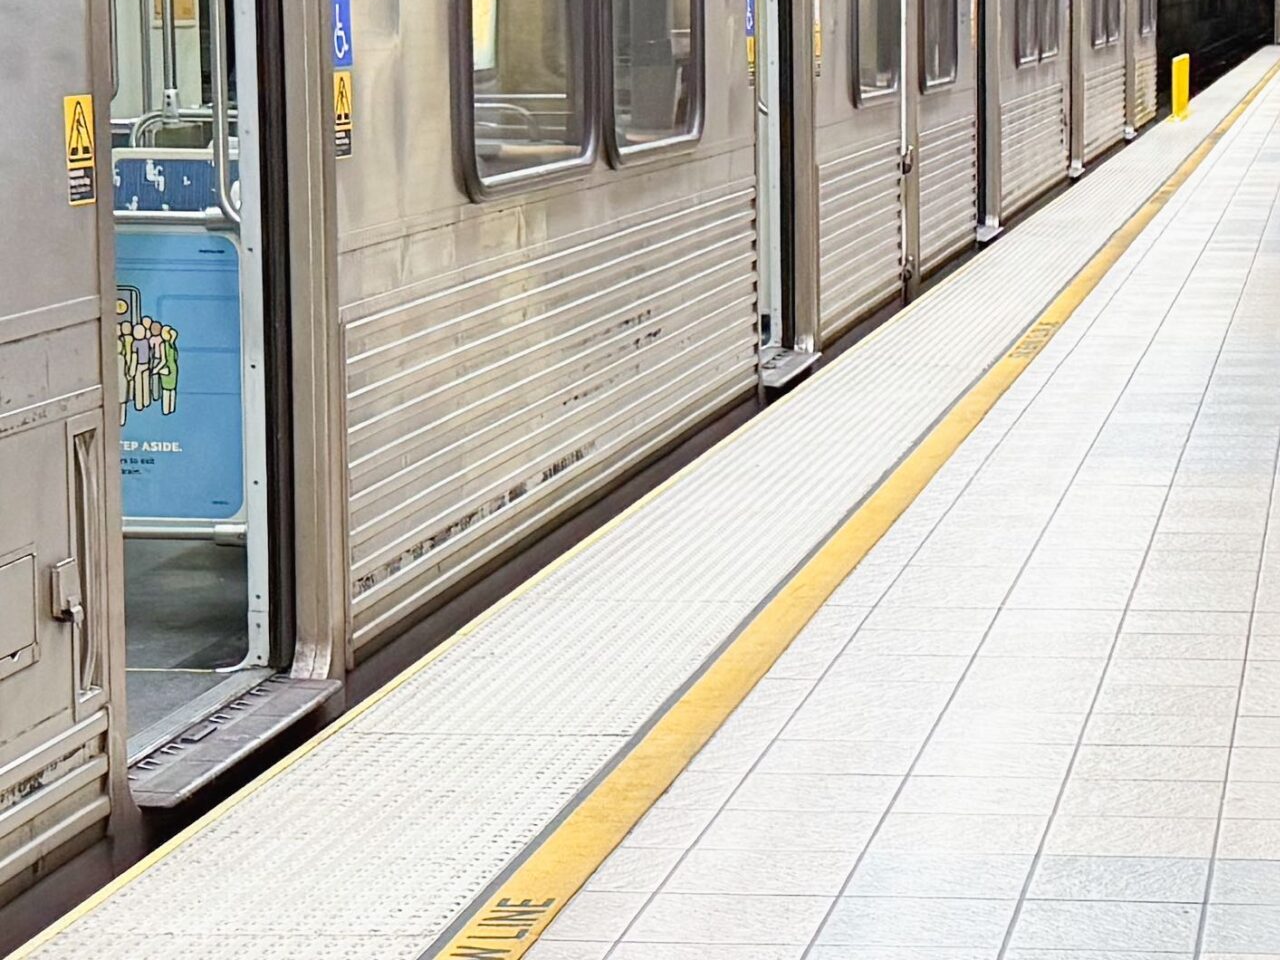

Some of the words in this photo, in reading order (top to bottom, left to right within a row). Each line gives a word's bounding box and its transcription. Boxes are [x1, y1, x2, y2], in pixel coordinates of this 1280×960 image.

[119, 440, 138, 452] EP
[142, 440, 183, 452] ASIDE.
[466, 898, 556, 940] LINE
